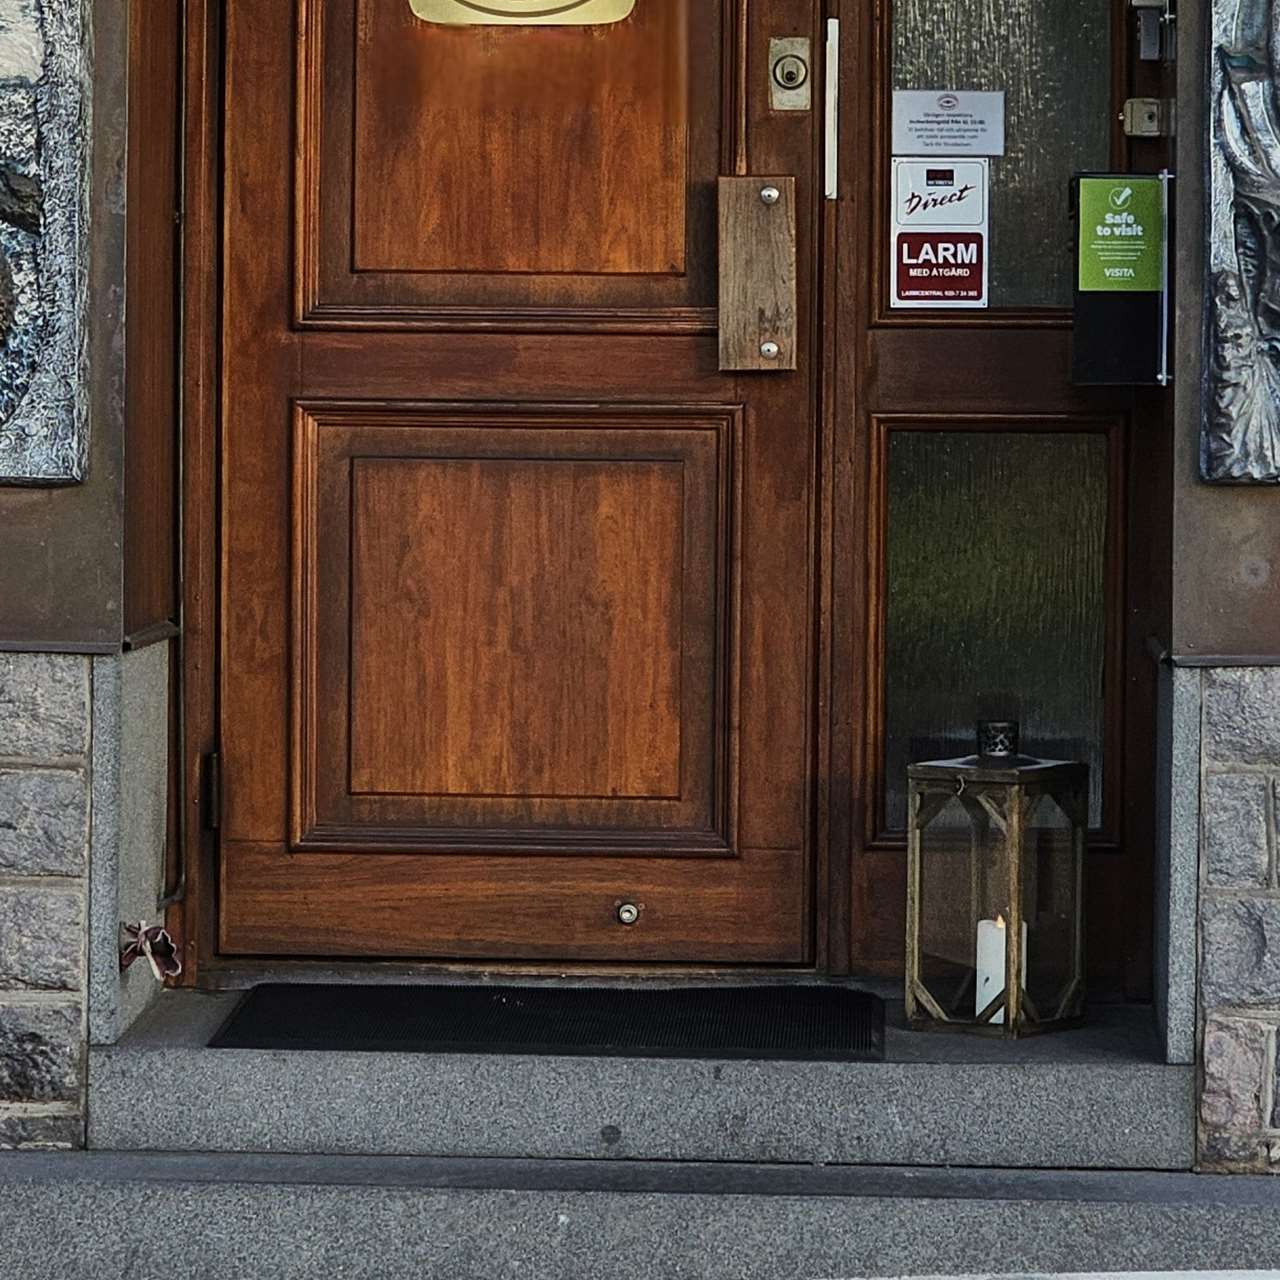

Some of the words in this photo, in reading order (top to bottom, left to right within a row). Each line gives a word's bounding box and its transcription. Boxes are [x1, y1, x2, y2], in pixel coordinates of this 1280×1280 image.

[904, 184, 977, 216] Direct
[1104, 212, 1135, 224] Safe
[1096, 225, 1111, 236] to
[1113, 224, 1143, 236] visit
[902, 242, 977, 264] LARM
[909, 268, 930, 277] MED
[1104, 268, 1135, 277] VISITA
